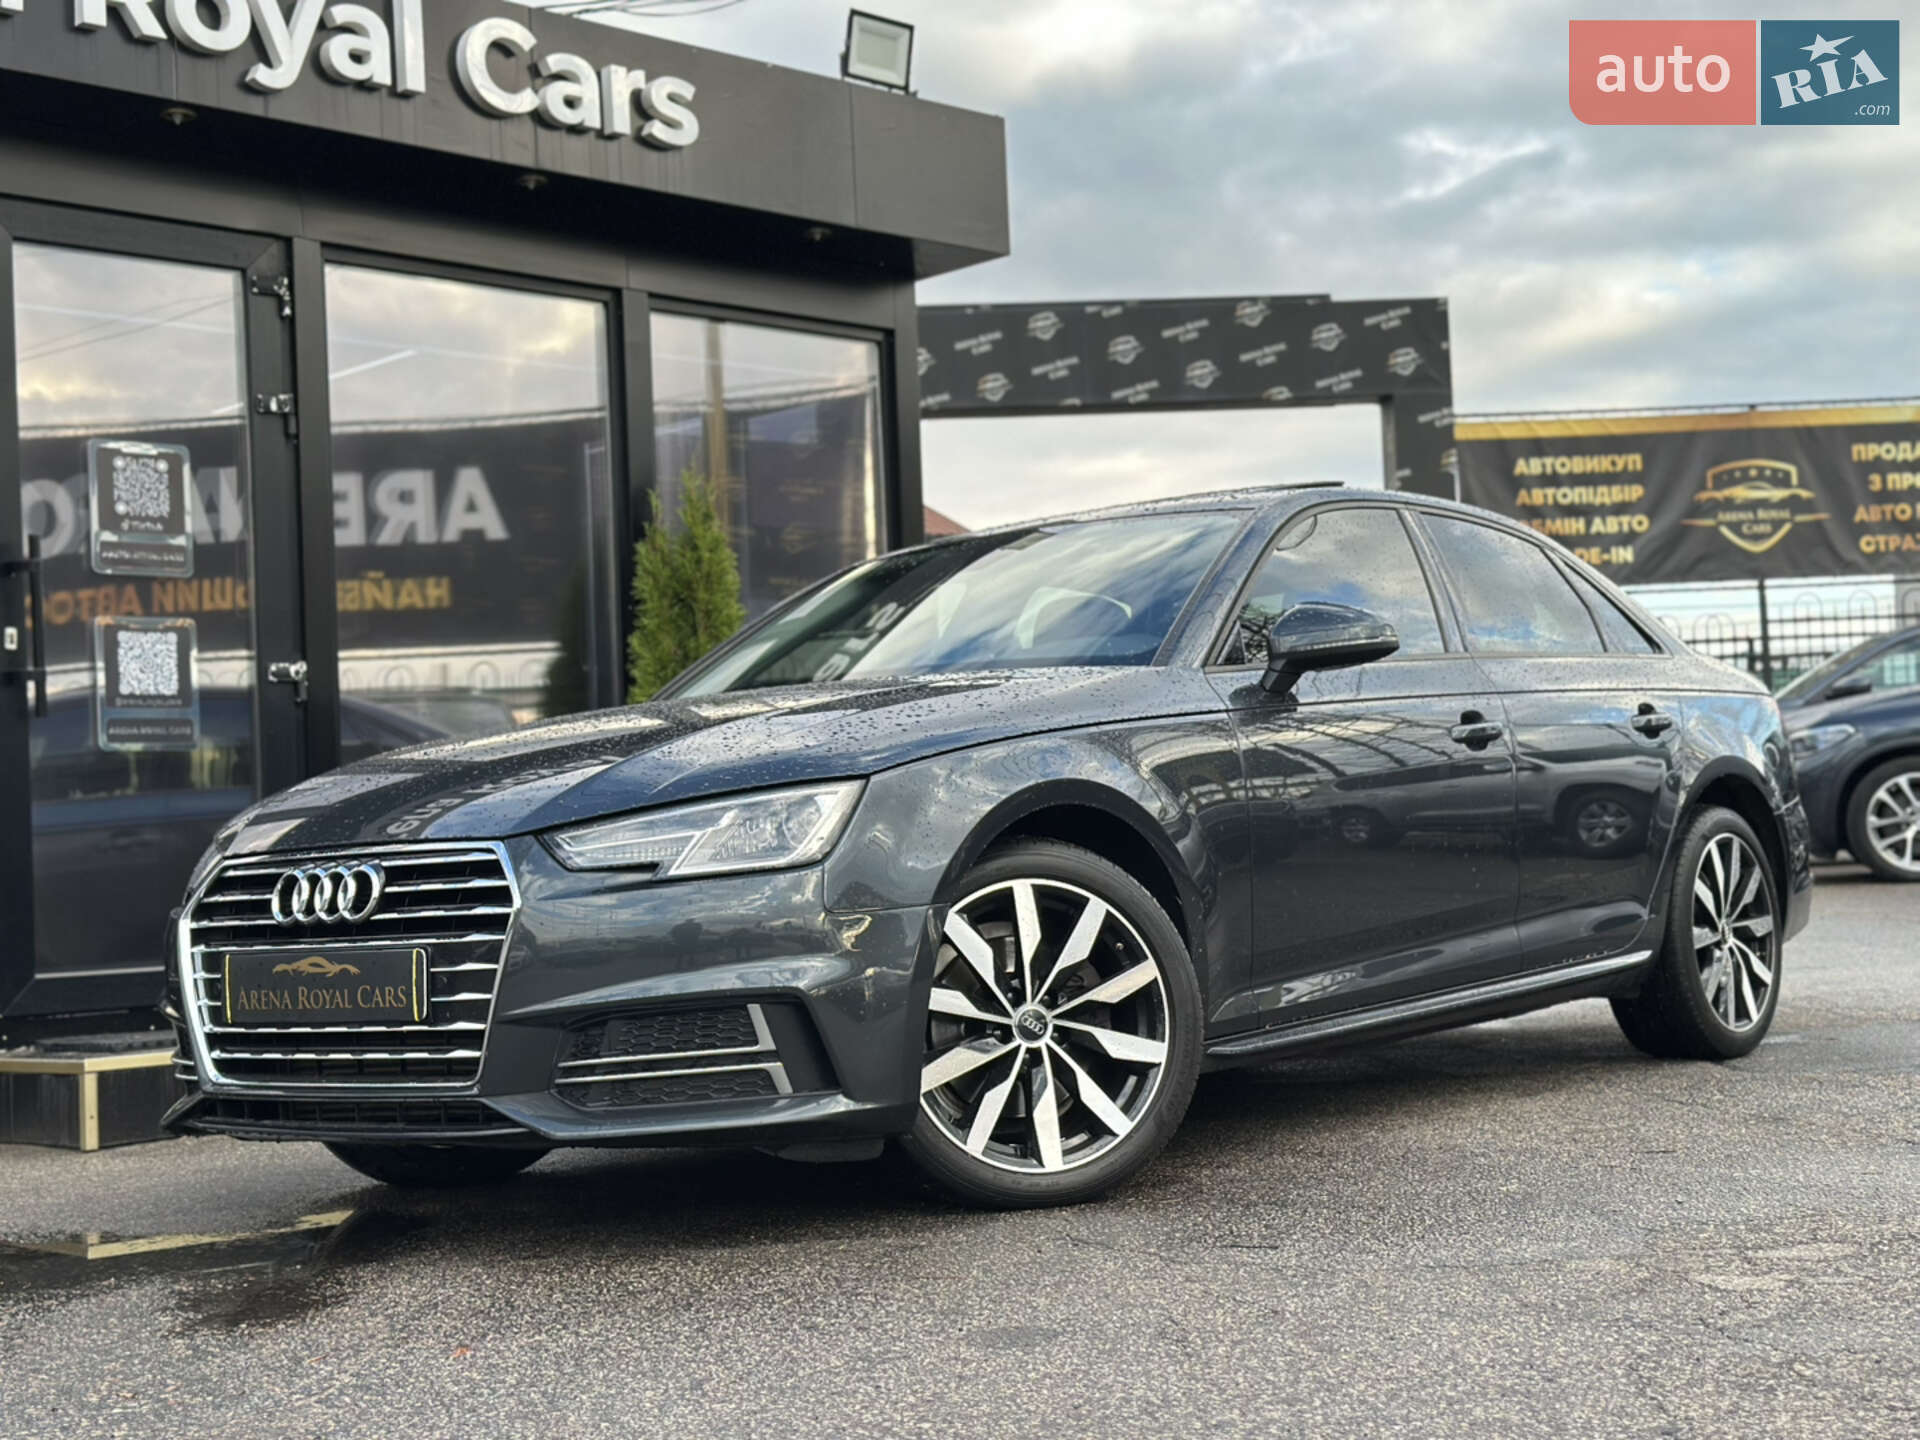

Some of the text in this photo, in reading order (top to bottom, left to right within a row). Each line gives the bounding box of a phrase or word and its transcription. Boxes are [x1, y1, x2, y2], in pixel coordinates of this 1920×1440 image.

[455, 17, 700, 150] Cars
[1513, 453, 1643, 477] АВТОВИКУП
[1515, 484, 1645, 508] АВТОПІДБІР
[1590, 514, 1650, 535] АВТО
[1854, 502, 1912, 524] АВТО
[238, 985, 407, 1010] ARENA ROYAL CARS
